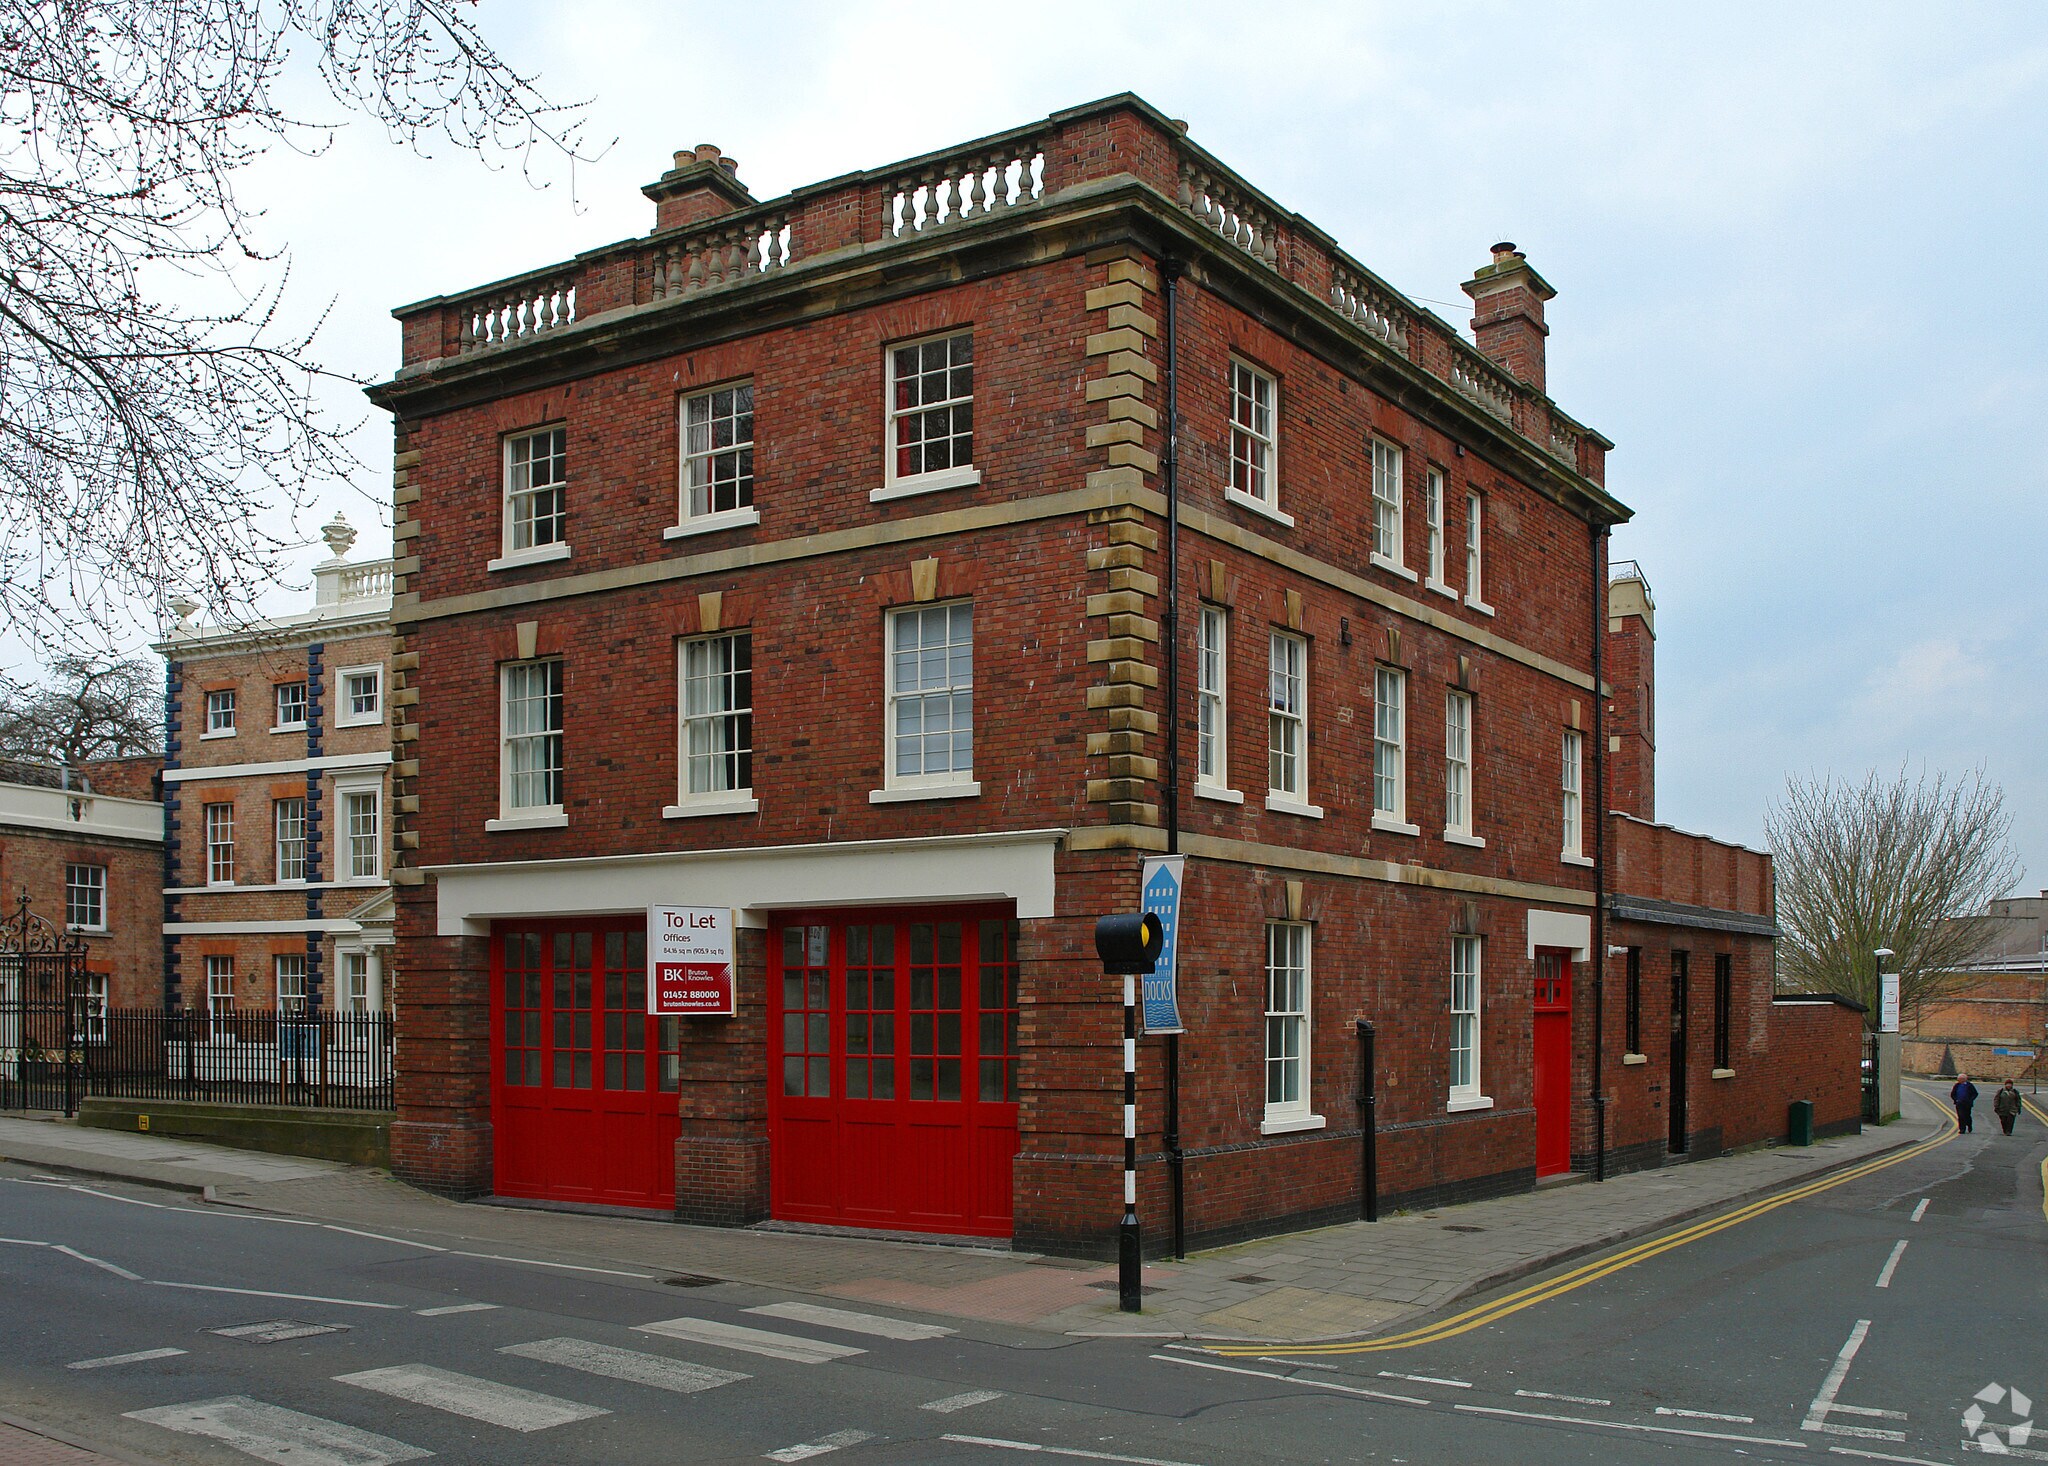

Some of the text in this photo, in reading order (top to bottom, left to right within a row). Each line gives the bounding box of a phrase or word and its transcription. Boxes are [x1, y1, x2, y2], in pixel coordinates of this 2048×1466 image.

[663, 912, 716, 929] To Let
[663, 933, 691, 943] Offices
[693, 947, 709, 956] (905.9
[663, 968, 684, 982] BK
[663, 990, 720, 999] 01452 880000
[1145, 981, 1171, 1001] DOCKS
